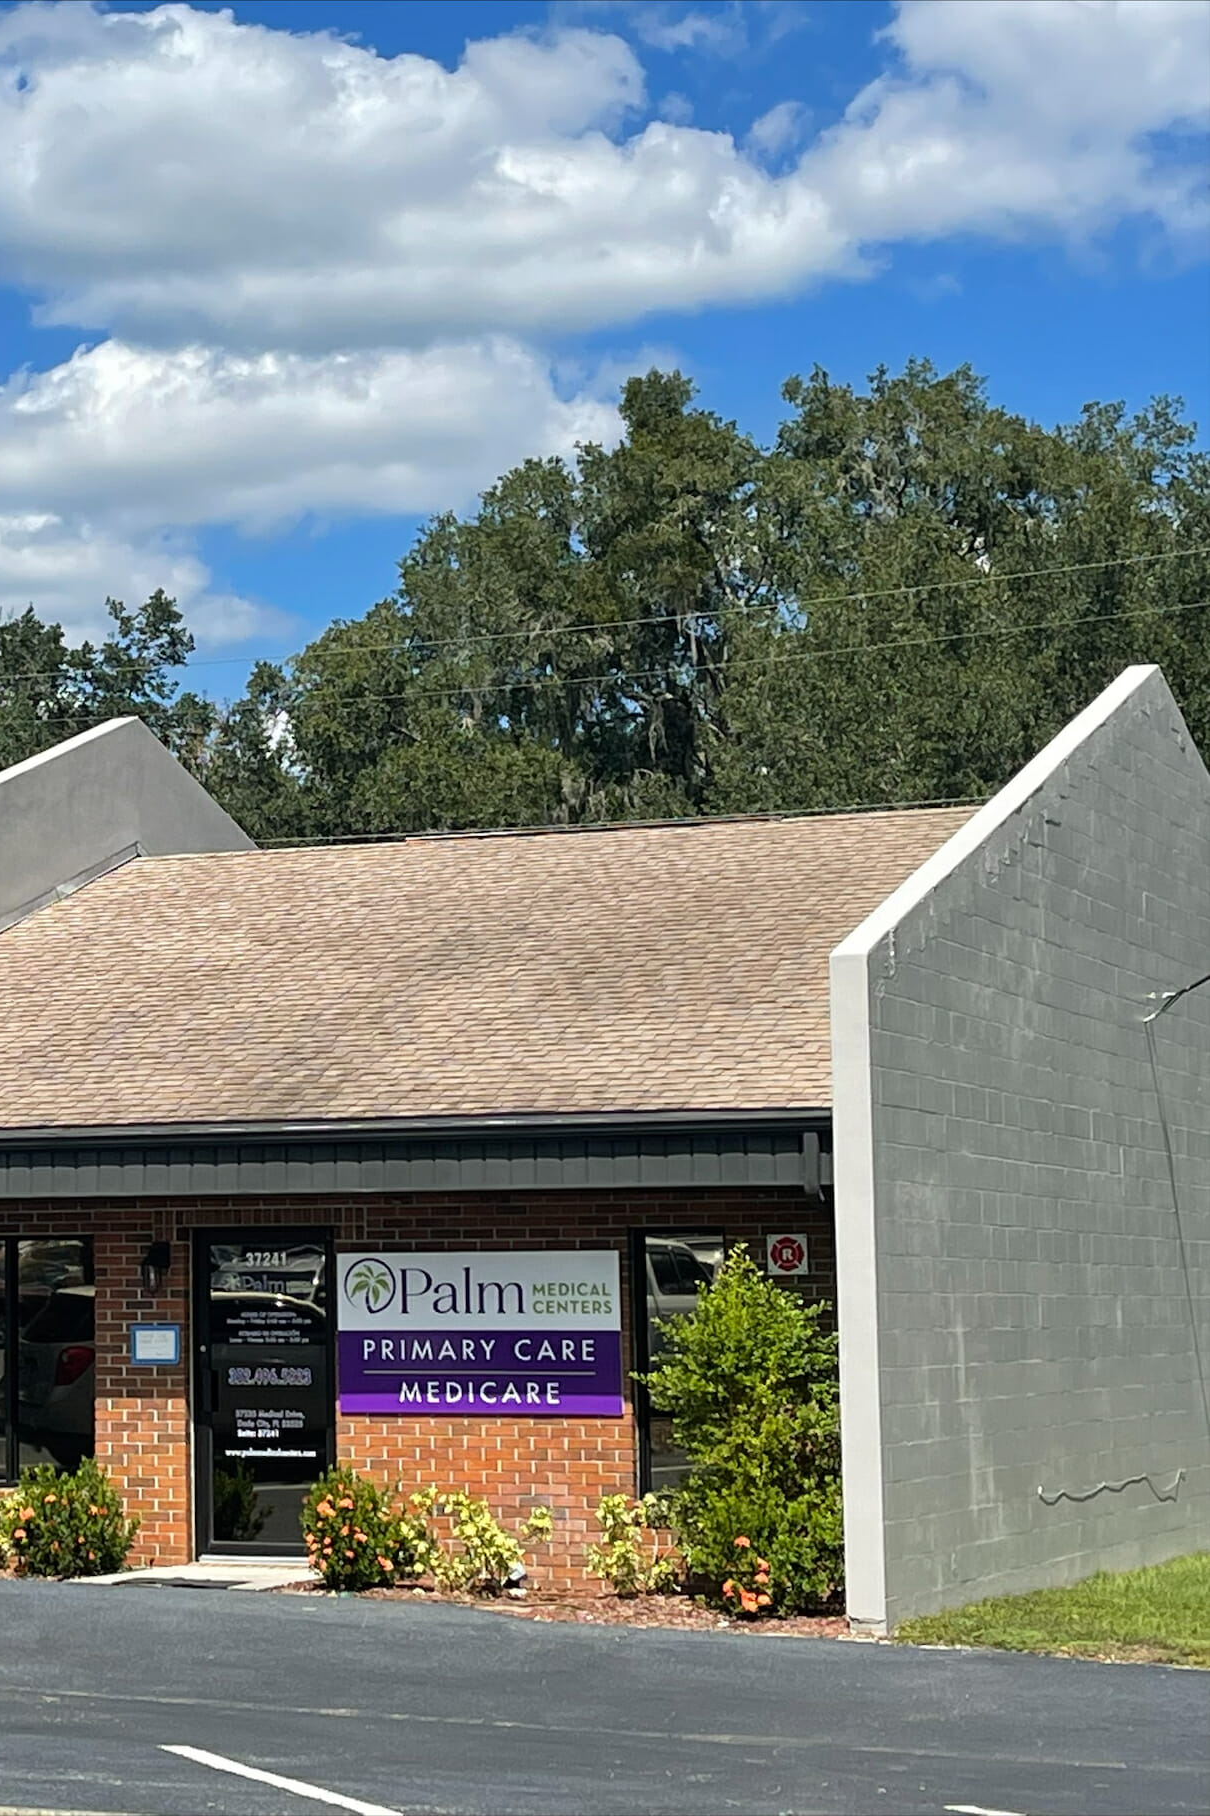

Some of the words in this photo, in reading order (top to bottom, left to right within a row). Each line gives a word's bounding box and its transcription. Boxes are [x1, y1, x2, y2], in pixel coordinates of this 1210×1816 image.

[245, 1252, 288, 1267] 37241
[782, 1248, 794, 1261] R
[241, 1274, 285, 1293] Palm
[398, 1267, 526, 1315] Palm
[532, 1282, 612, 1297] MEDICAL
[532, 1300, 613, 1315] CENTERS
[362, 1339, 496, 1362] PRIMARY
[513, 1339, 597, 1362] CARE
[398, 1381, 562, 1405] MEDICARE
